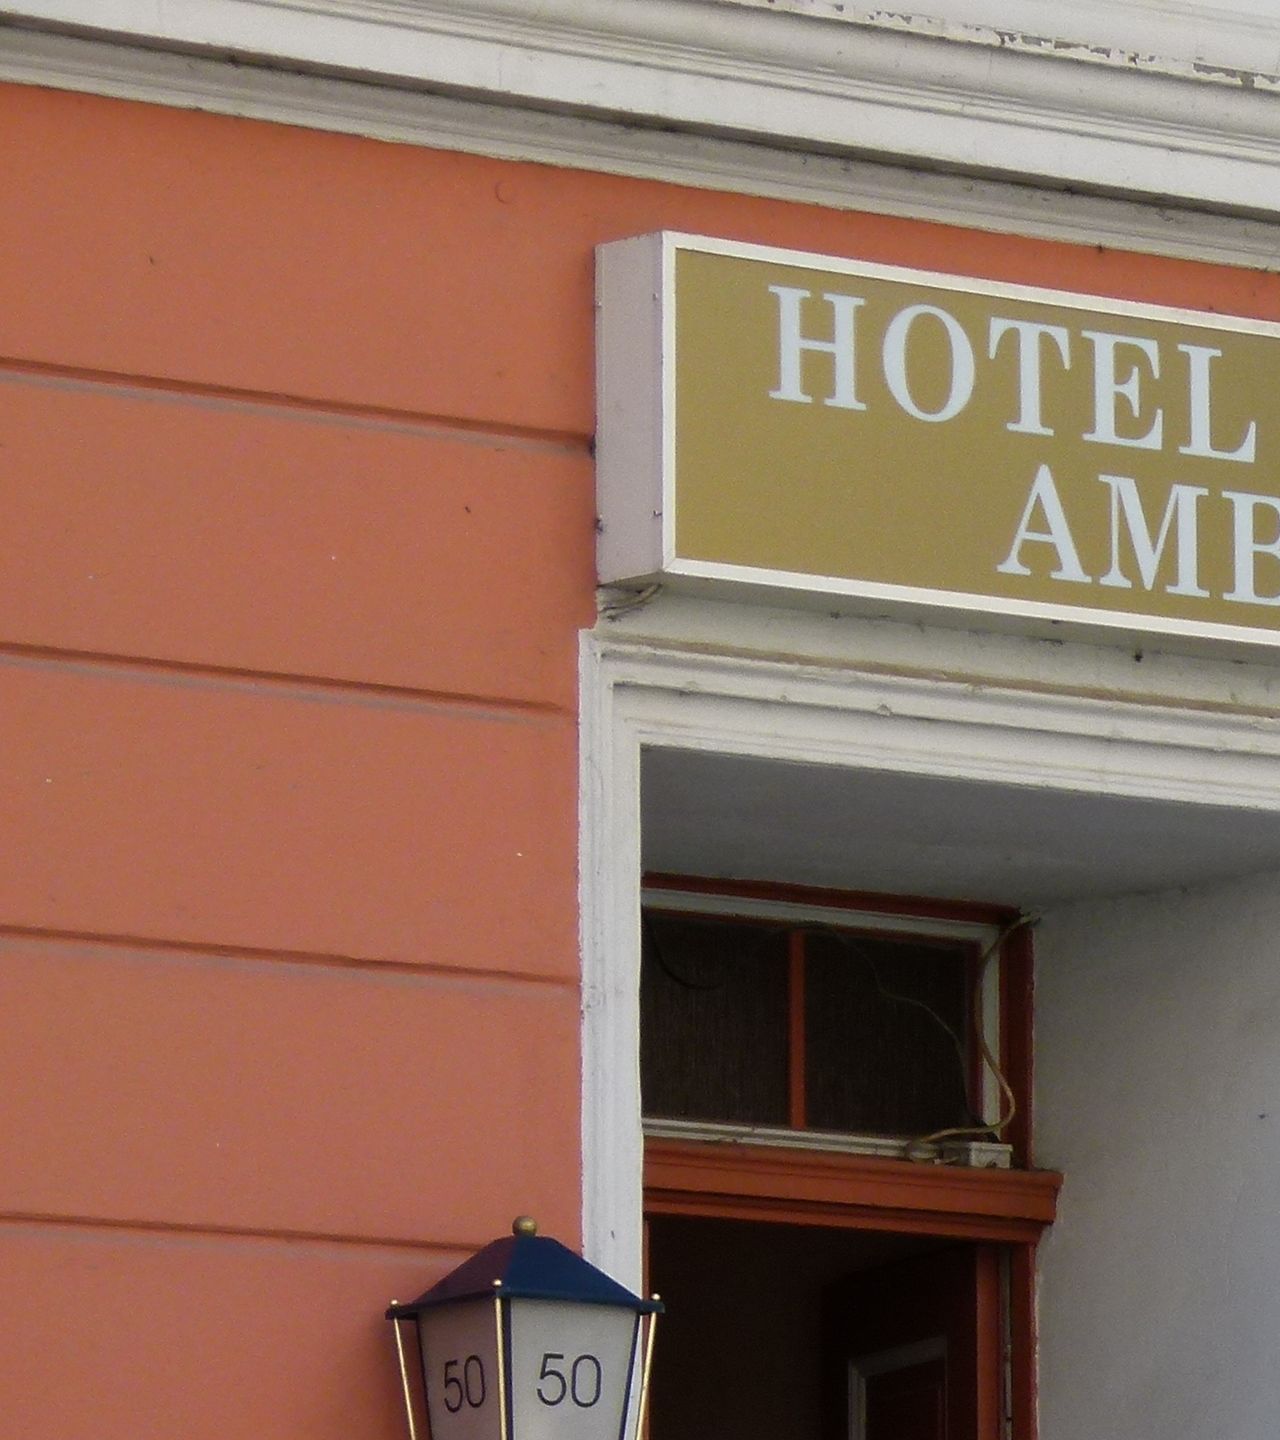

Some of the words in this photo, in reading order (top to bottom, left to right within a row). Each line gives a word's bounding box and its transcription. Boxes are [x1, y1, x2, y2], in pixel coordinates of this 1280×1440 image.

[767, 284, 1257, 464] HOTEL
[442, 1354, 487, 1414] 50
[536, 1353, 602, 1409] 50
